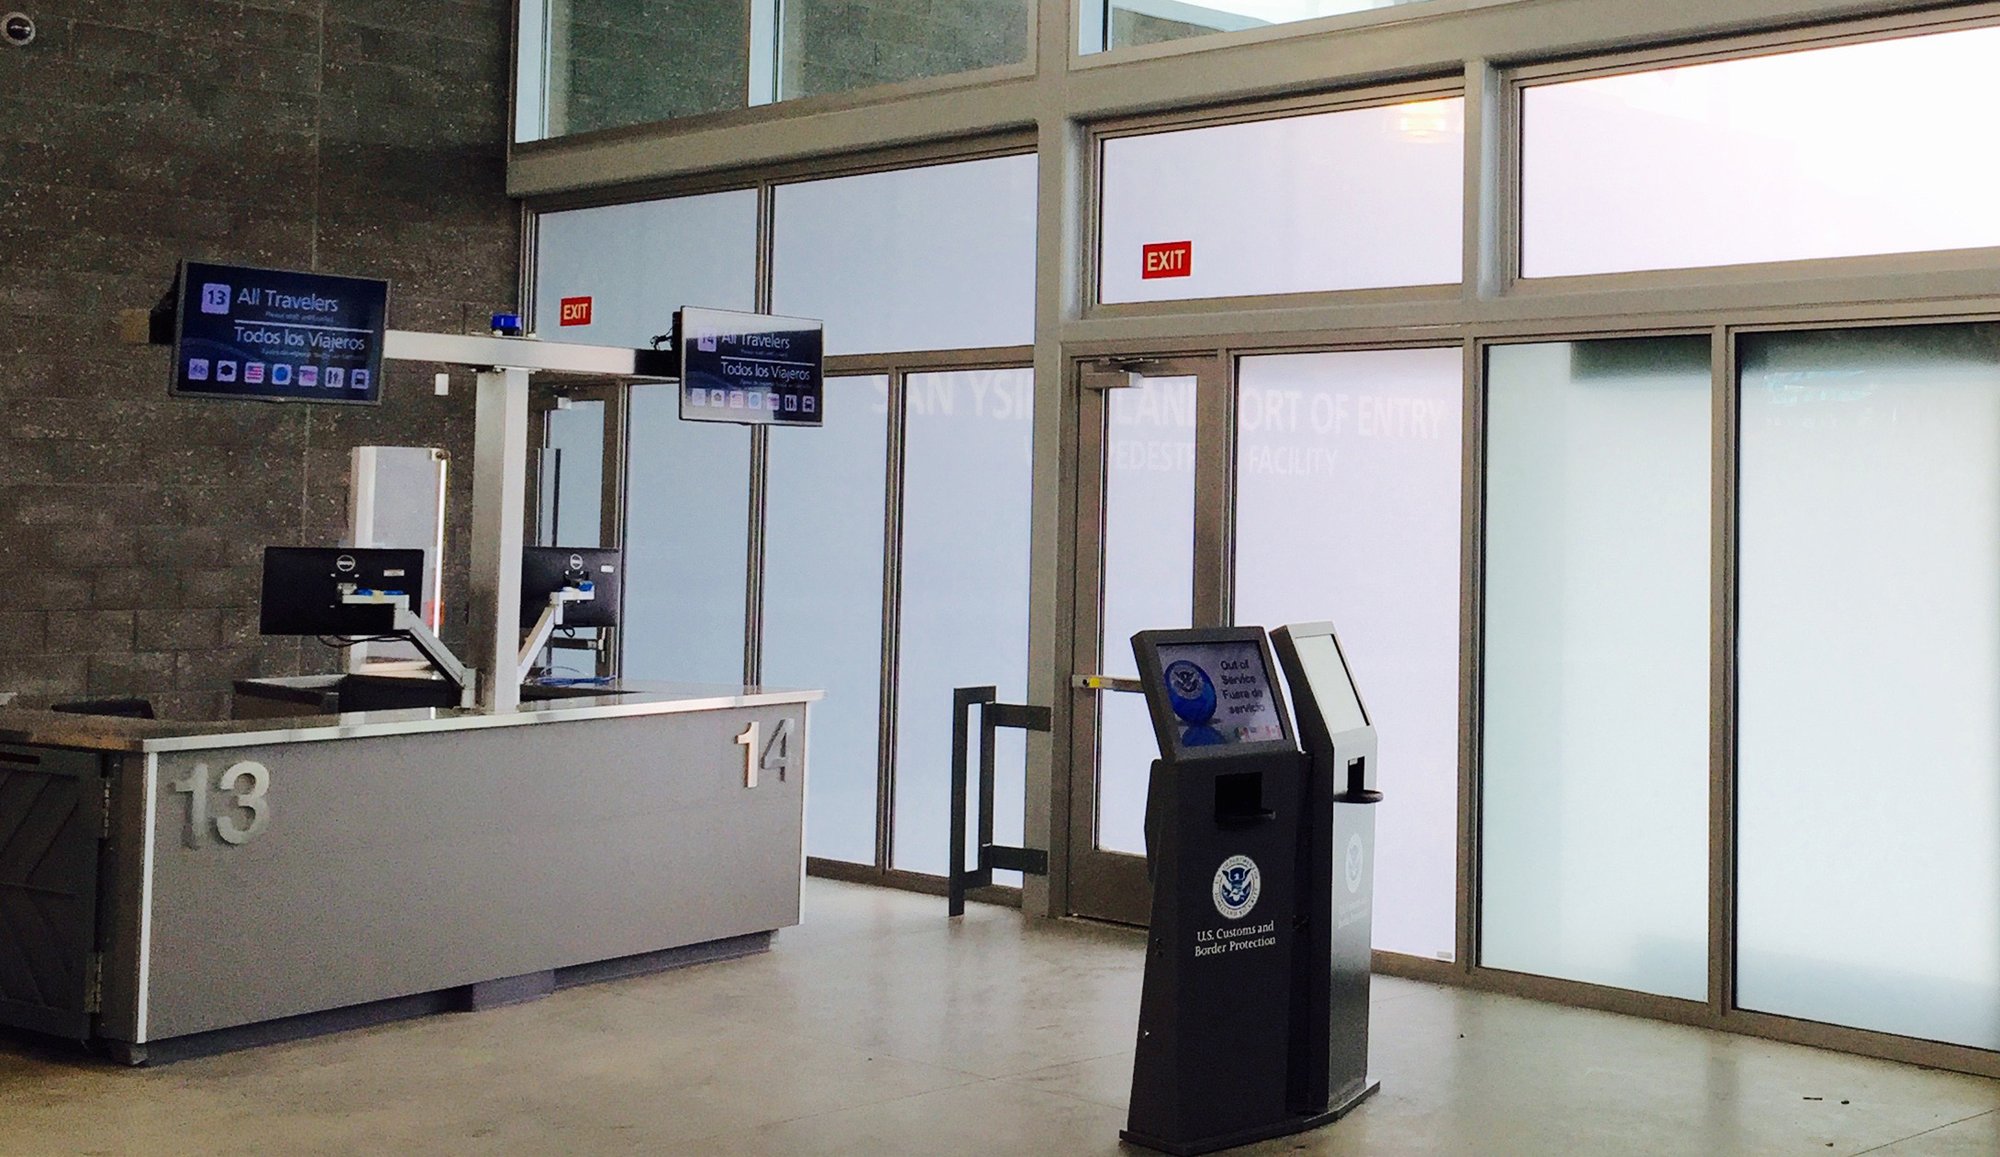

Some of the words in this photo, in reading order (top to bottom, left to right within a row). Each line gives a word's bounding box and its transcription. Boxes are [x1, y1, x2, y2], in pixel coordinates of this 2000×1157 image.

[1147, 249, 1186, 272] EXIT
[207, 289, 227, 306] 13
[237, 287, 261, 306] All
[265, 289, 339, 312] Travelers
[563, 303, 589, 320] EXIT
[234, 326, 281, 345] Todos
[284, 329, 305, 347] los
[308, 331, 366, 352] Viajeros
[741, 333, 791, 350] Travelers
[721, 361, 753, 377] Todos
[755, 363, 769, 378] los
[770, 365, 811, 383] Viajeros
[1310, 391, 1350, 435] OF
[1357, 394, 1446, 440] ENTRY
[1248, 444, 1339, 476] FACILITY
[1220, 660, 1238, 671] Out
[1240, 659, 1250, 670] of
[1220, 674, 1257, 685] Service
[1222, 689, 1250, 700] Fuera
[1251, 687, 1264, 698] de
[734, 718, 796, 789] 14
[172, 760, 270, 846] 13
[1197, 930, 1215, 943] U.S.
[1216, 925, 1257, 940] Customs
[1257, 919, 1275, 934] and
[1194, 943, 1228, 957] Border
[1229, 935, 1277, 951] Protection
